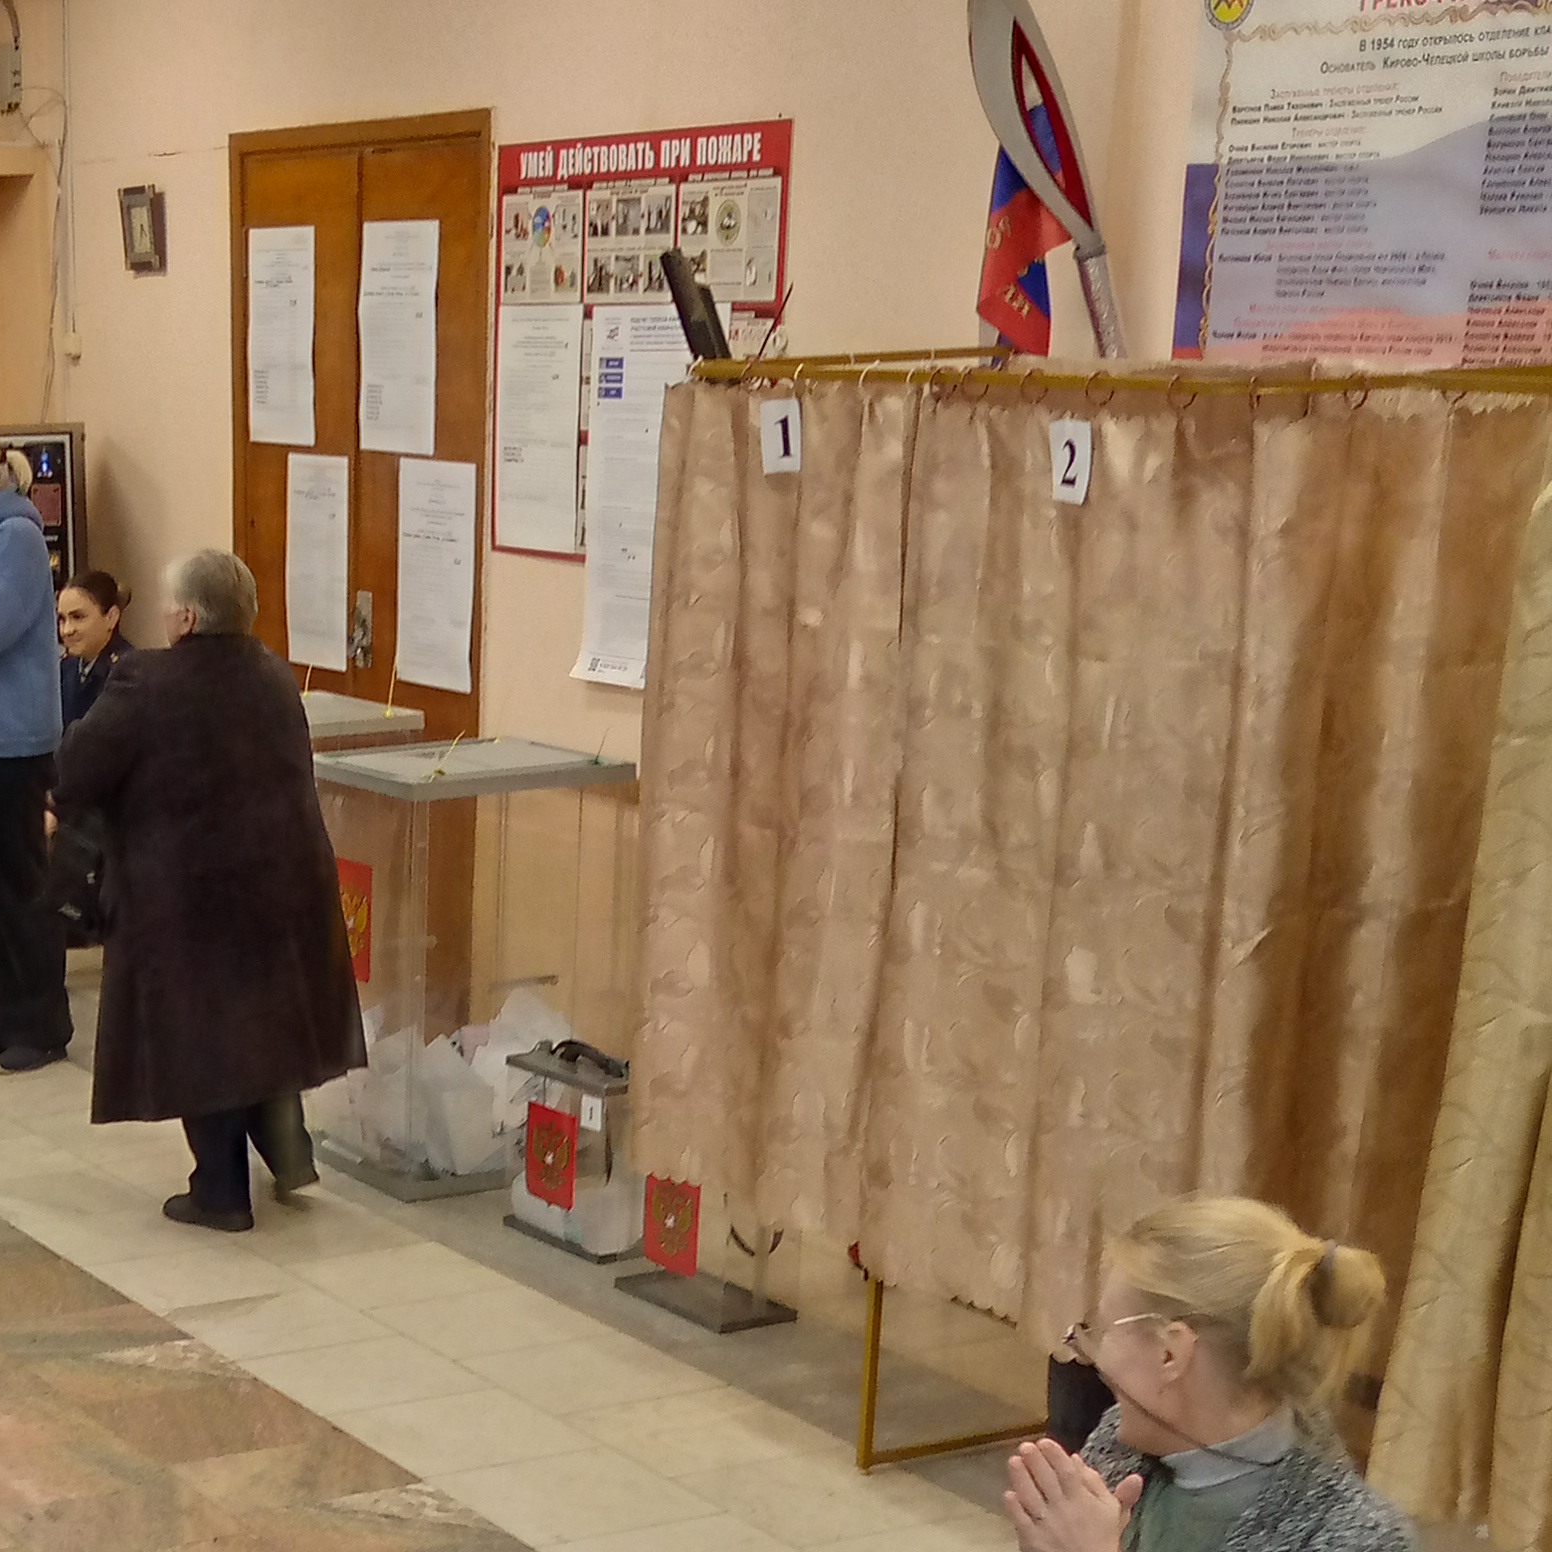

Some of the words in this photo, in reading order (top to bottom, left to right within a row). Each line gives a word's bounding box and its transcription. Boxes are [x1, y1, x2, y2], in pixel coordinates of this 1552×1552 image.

[1371, 38, 1395, 50] 1954
[519, 146, 554, 180] УМЕЙ
[558, 141, 655, 180] ДЕЙСТВОВАТЬ
[660, 137, 691, 168] ПРИ
[697, 132, 762, 166] ПОЖАРЕ
[774, 415, 791, 458] 1
[1060, 439, 1078, 486] 2
